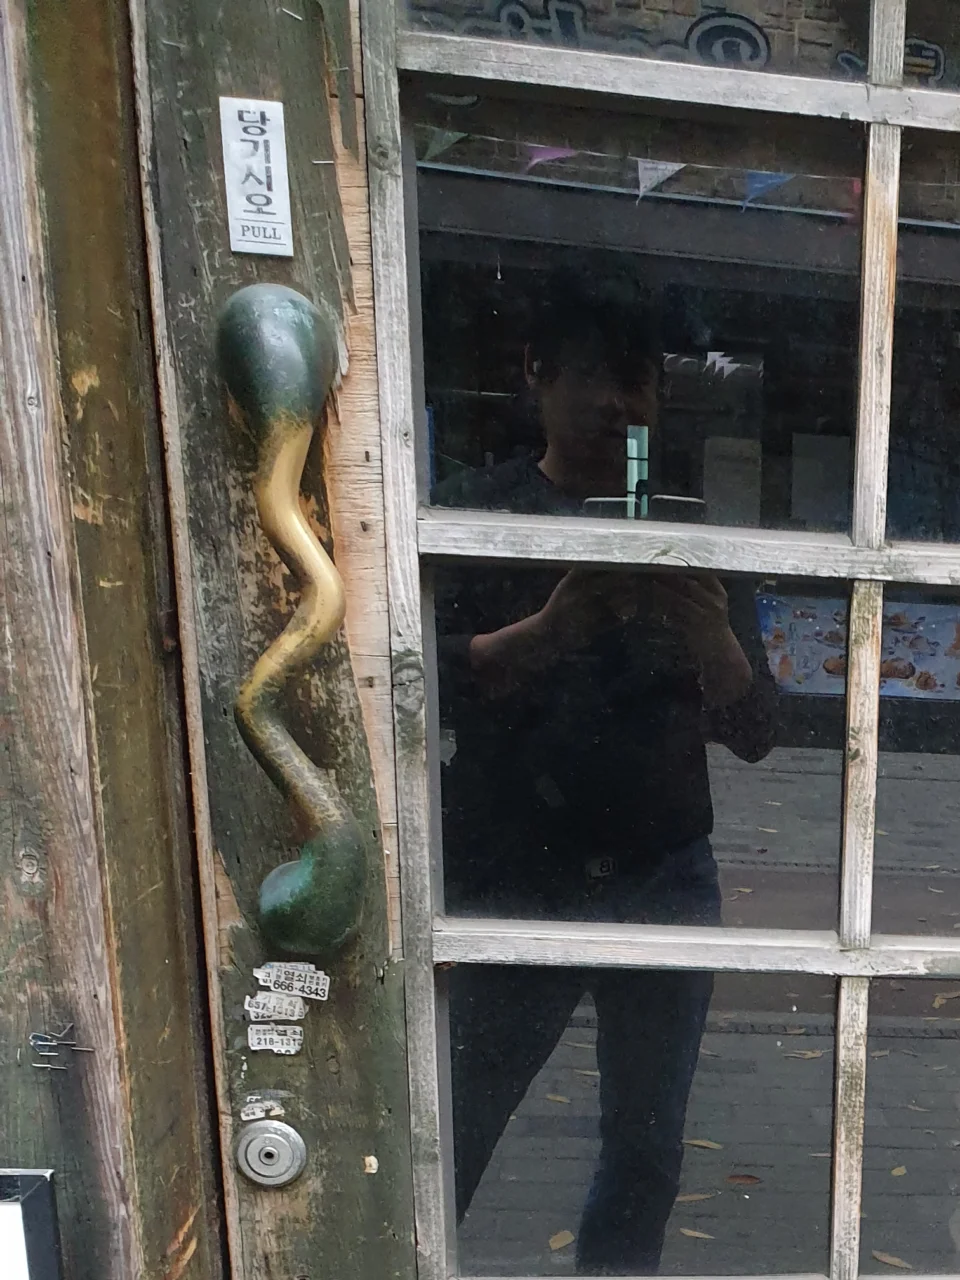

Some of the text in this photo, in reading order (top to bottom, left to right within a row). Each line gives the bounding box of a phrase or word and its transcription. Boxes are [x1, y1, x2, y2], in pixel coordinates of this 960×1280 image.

[238, 110, 276, 215] 당기시오
[241, 225, 281, 240] PULL
[273, 980, 326, 998] 666-4343
